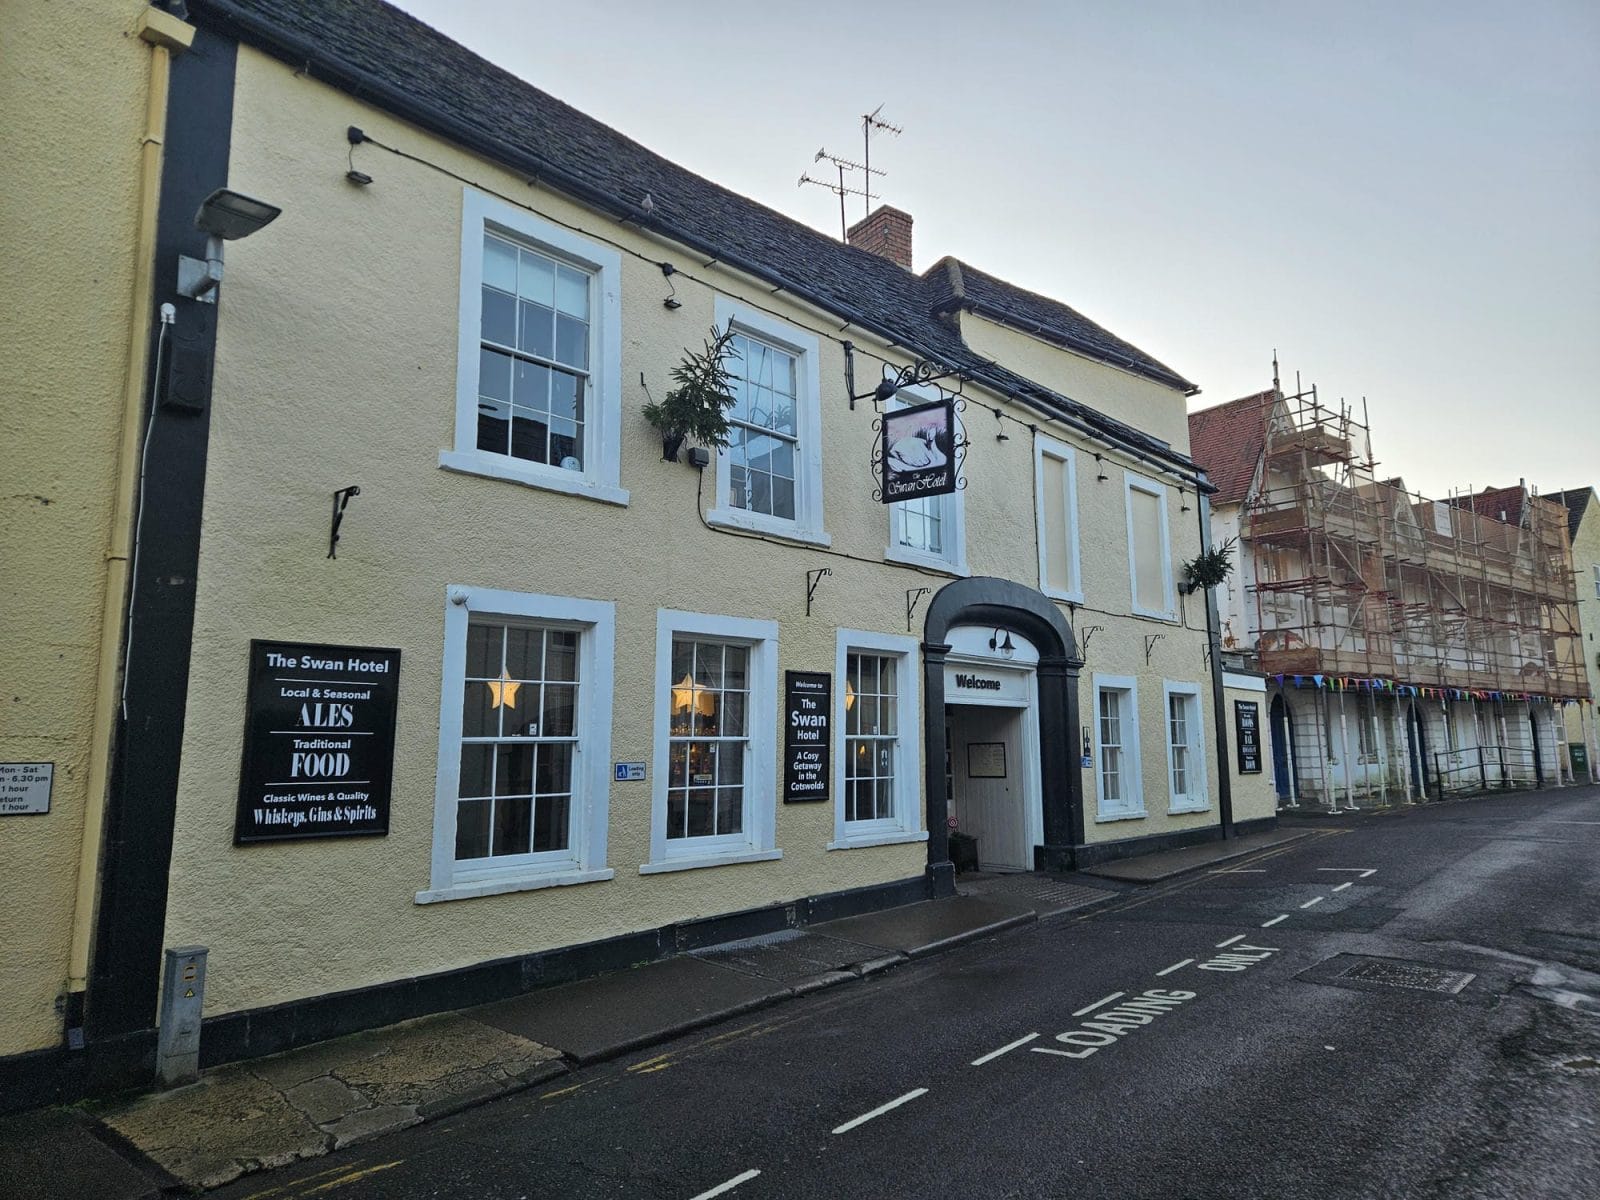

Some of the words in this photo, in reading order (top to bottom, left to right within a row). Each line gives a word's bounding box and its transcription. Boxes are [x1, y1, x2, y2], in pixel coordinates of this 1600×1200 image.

[266, 653, 297, 668] The
[300, 655, 344, 671] Swan
[347, 658, 389, 673] Hotel
[796, 681, 817, 689] Welcome
[955, 674, 1001, 691] Welcome
[280, 687, 309, 698] Local
[312, 688, 321, 698] &
[323, 688, 371, 700] Seasonal
[801, 698, 817, 709] The
[296, 702, 354, 728] ALES
[791, 710, 827, 727] Swan
[797, 729, 820, 740] Hotel
[293, 739, 351, 750] Traditional
[796, 751, 802, 760] A
[803, 751, 820, 762] Cosy
[23, 766, 39, 774] Sat
[291, 753, 350, 777] FOOD
[793, 762, 822, 772] Getaway
[12, 775, 34, 783] 6.30
[35, 775, 49, 783] pm
[798, 771, 805, 780] in
[806, 770, 817, 780] the
[8, 785, 30, 793] hour
[790, 780, 825, 790] Cotswolds
[263, 794, 297, 803] Classic
[297, 793, 326, 802] Wines
[327, 792, 335, 801] &
[336, 791, 370, 802] Quality
[2, 803, 6, 811] 1
[8, 803, 30, 811] hour
[308, 806, 333, 823] Gins
[333, 805, 343, 821] &
[343, 804, 377, 824] Spirits
[1198, 944, 1280, 972] ONLY
[1030, 989, 1197, 1059] LOADING
